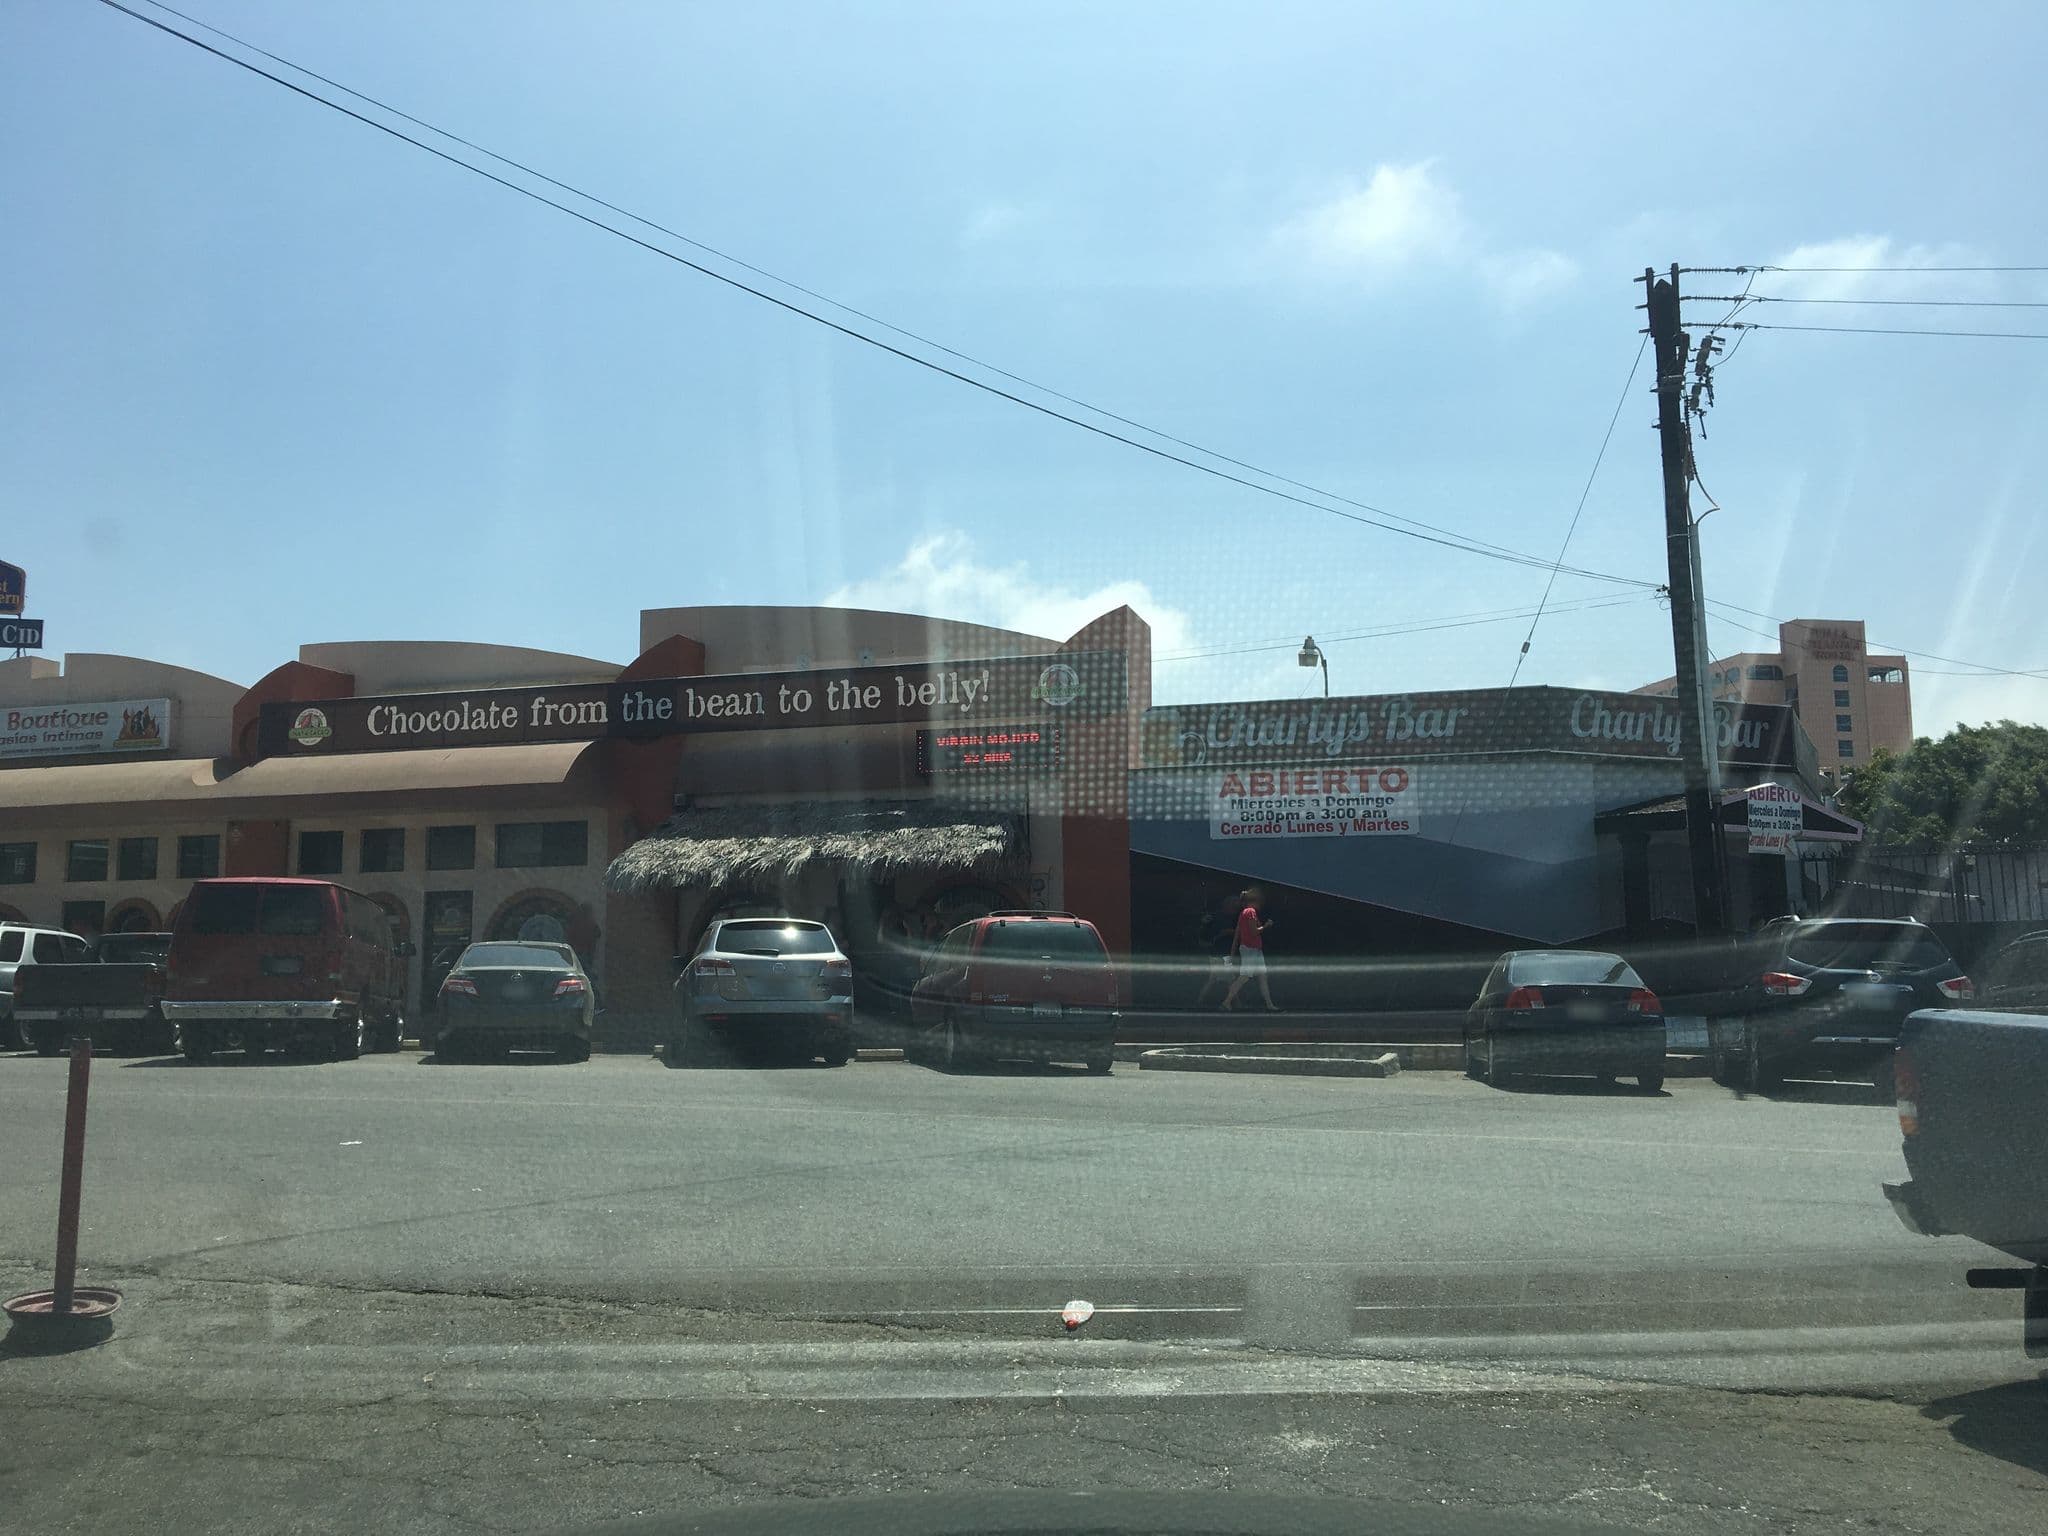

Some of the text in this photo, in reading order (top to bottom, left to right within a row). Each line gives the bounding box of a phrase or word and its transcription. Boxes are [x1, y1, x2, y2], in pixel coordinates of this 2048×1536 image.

[367, 670, 990, 736] Chocolate from the bean to the belly!
[1381, 701, 1469, 741] Bar
[1571, 694, 1769, 755] Charly Bar
[1219, 768, 1409, 798] ABIERTO
[1749, 787, 1800, 802] ABIERTO
[1305, 809, 1316, 820] a
[1321, 808, 1356, 819] 3:00
[1362, 808, 1388, 818] am
[1325, 796, 1395, 808] Domingo
[1220, 818, 1410, 836] Cerrado Lunes y Martes
